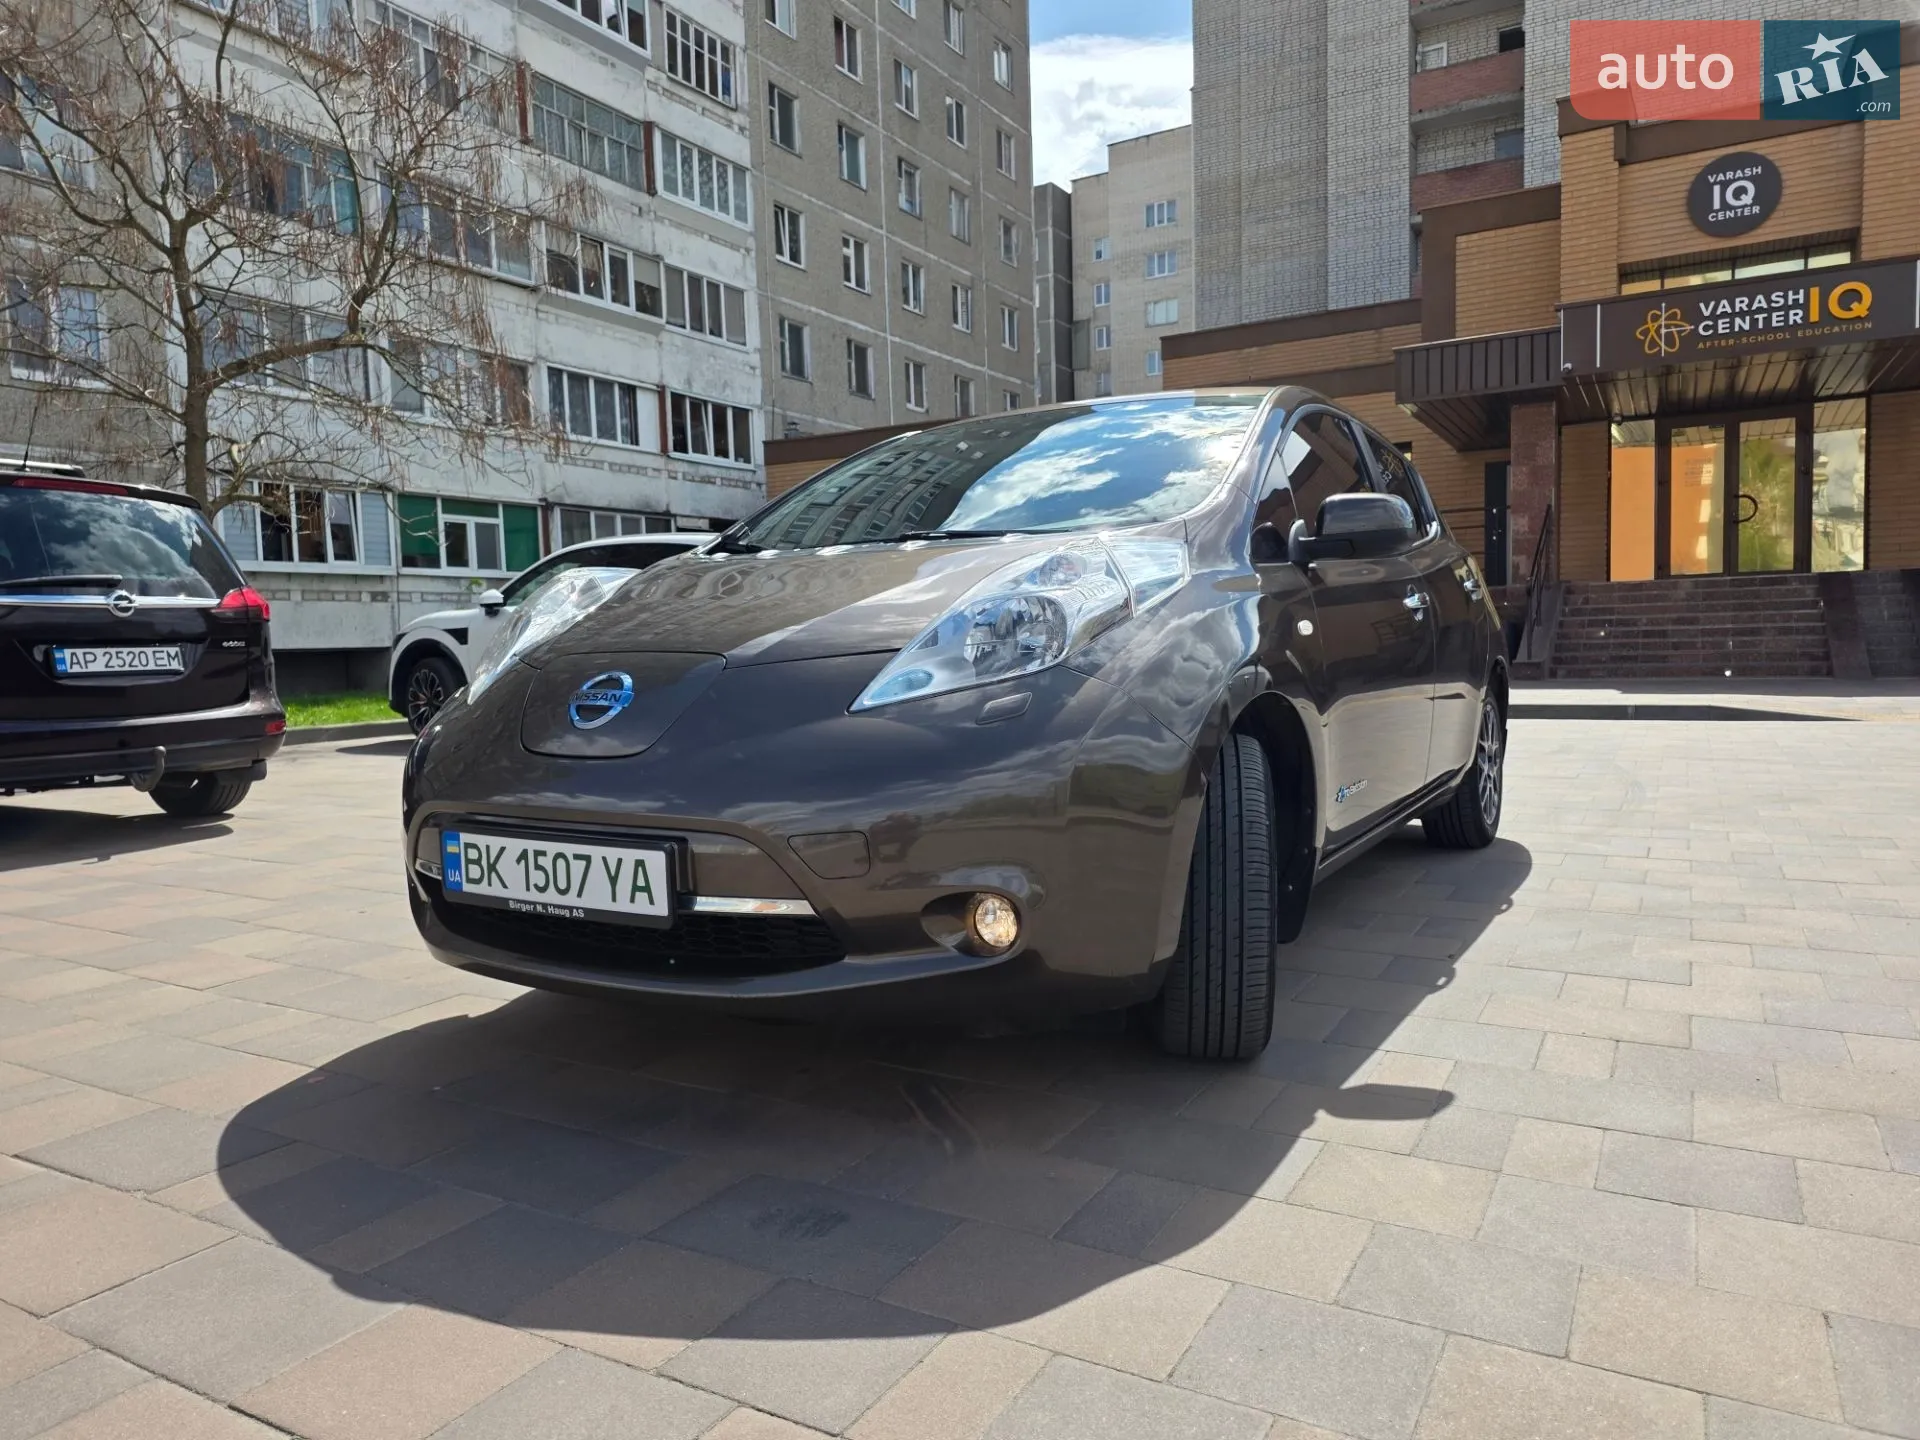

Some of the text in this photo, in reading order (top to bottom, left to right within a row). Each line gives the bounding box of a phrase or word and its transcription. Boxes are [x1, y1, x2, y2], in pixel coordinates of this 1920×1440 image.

[1708, 166, 1762, 183] VARASH
[1713, 180, 1755, 210] IQ
[1708, 205, 1760, 222] CENTER
[1699, 289, 1805, 317] VARASH
[1809, 281, 1873, 323] IQ
[1698, 309, 1803, 336] CENTER
[1697, 322, 1873, 349] AFTER-SCHOOL EDUCATION
[69, 650, 181, 669] AP 2520 EM
[571, 691, 622, 703] NISSAN
[447, 869, 461, 883] UA
[463, 842, 655, 906] BK 1507 YA
[508, 900, 585, 918] Birger N. Haug AS
